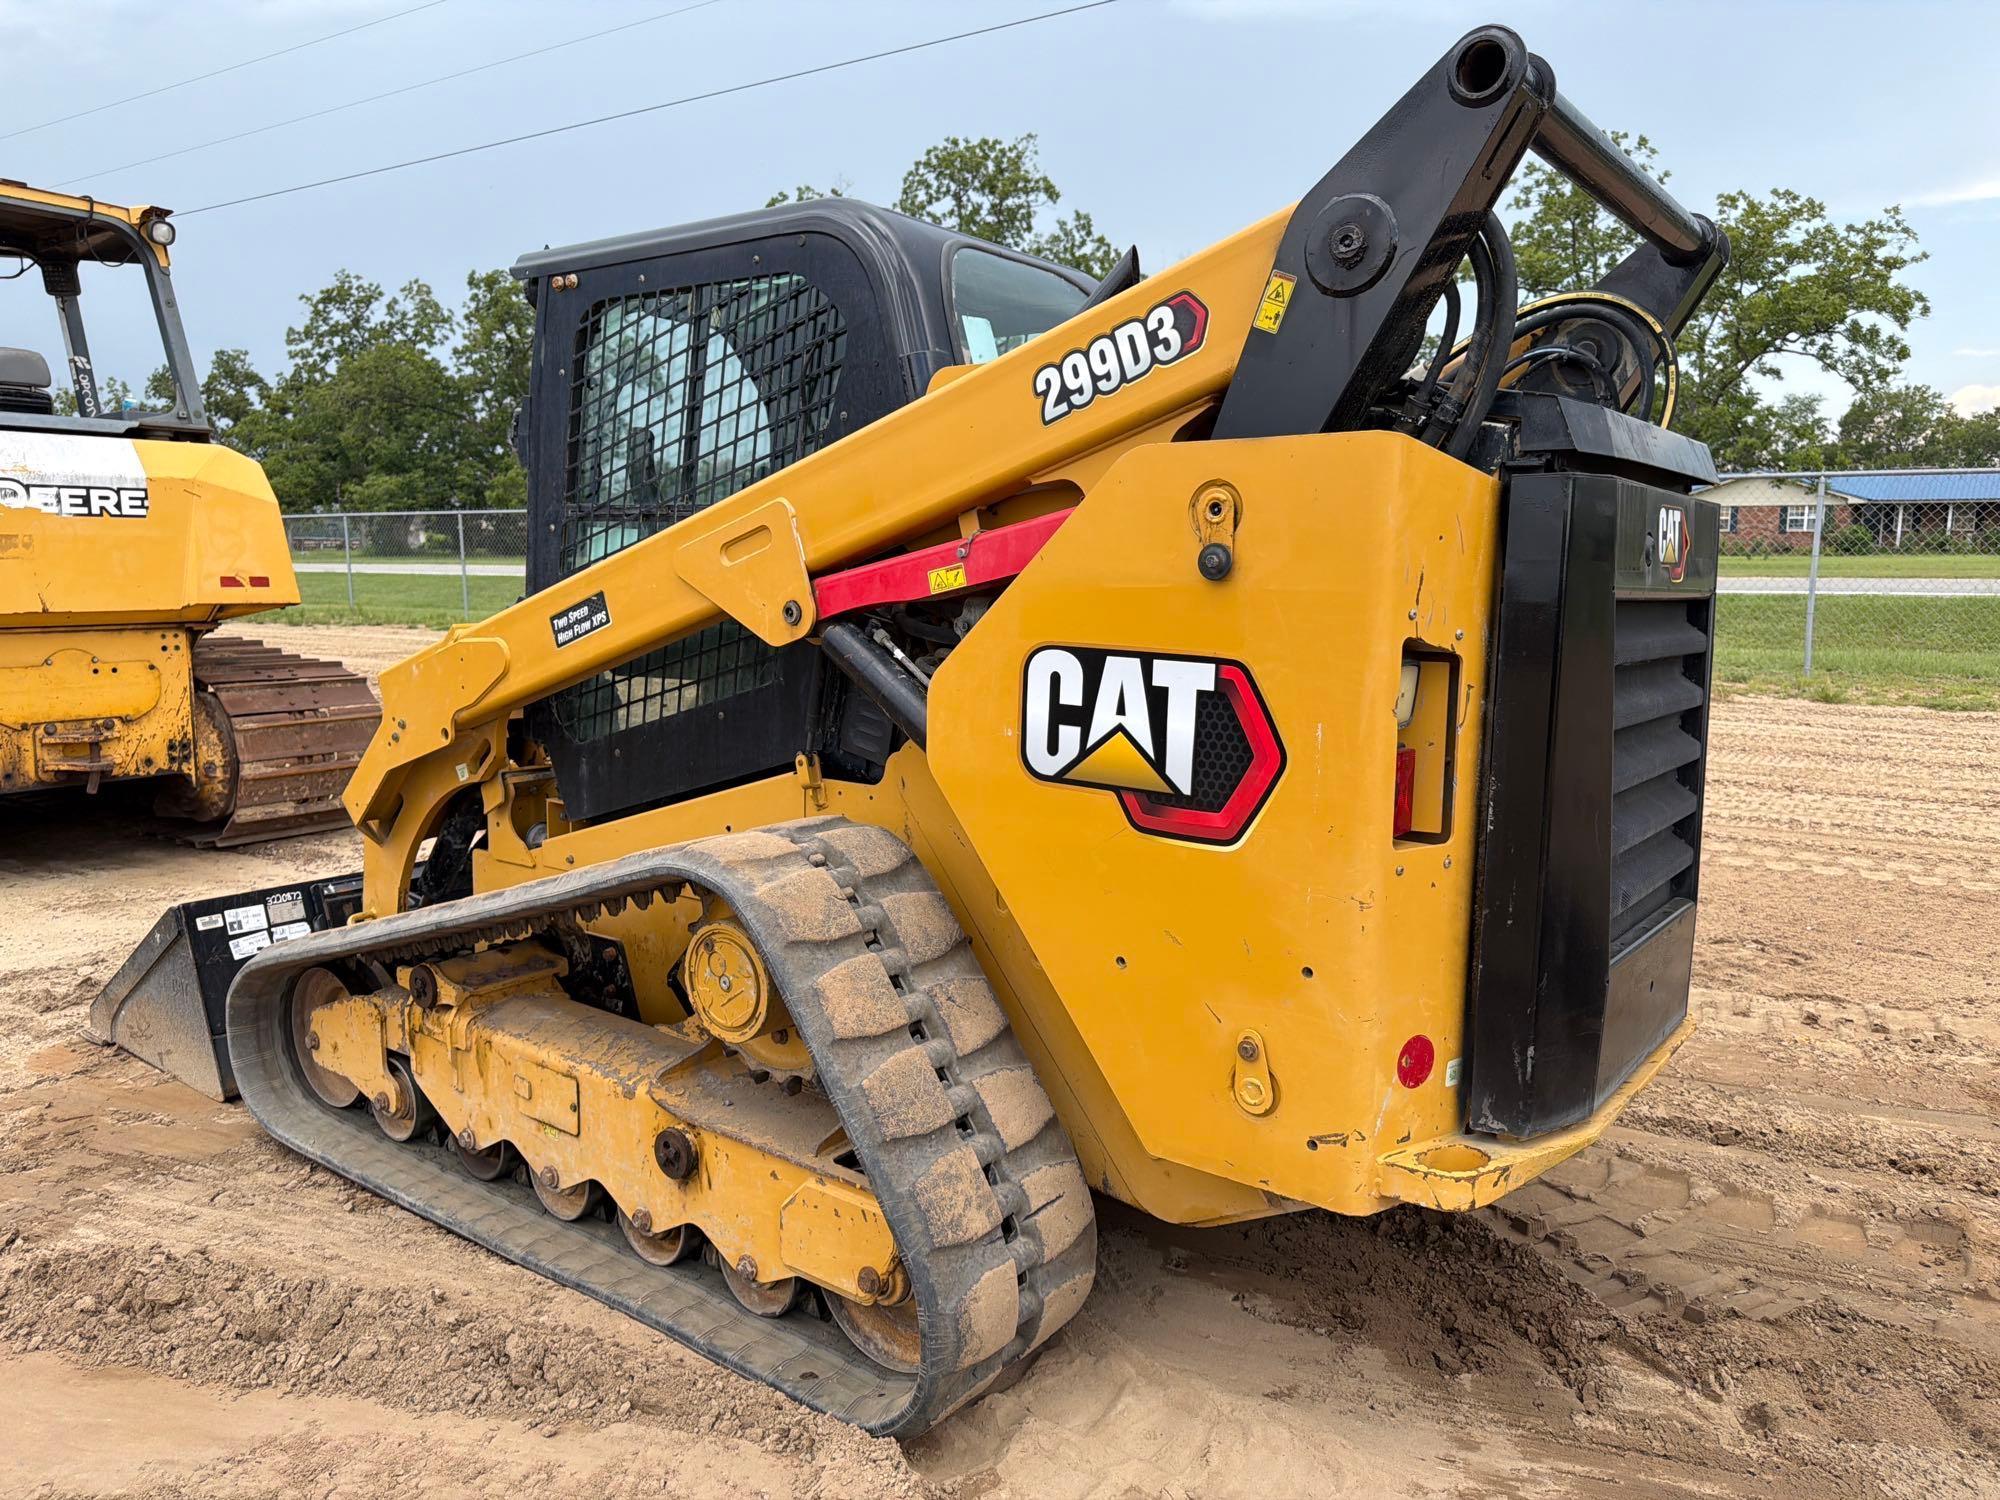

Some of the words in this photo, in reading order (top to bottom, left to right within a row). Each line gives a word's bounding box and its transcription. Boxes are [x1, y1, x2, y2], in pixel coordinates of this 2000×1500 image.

[1035, 305, 1182, 422] 299D3
[1659, 507, 1681, 563] CAT
[592, 611, 606, 628] XPS
[1026, 649, 1216, 796] CAT
